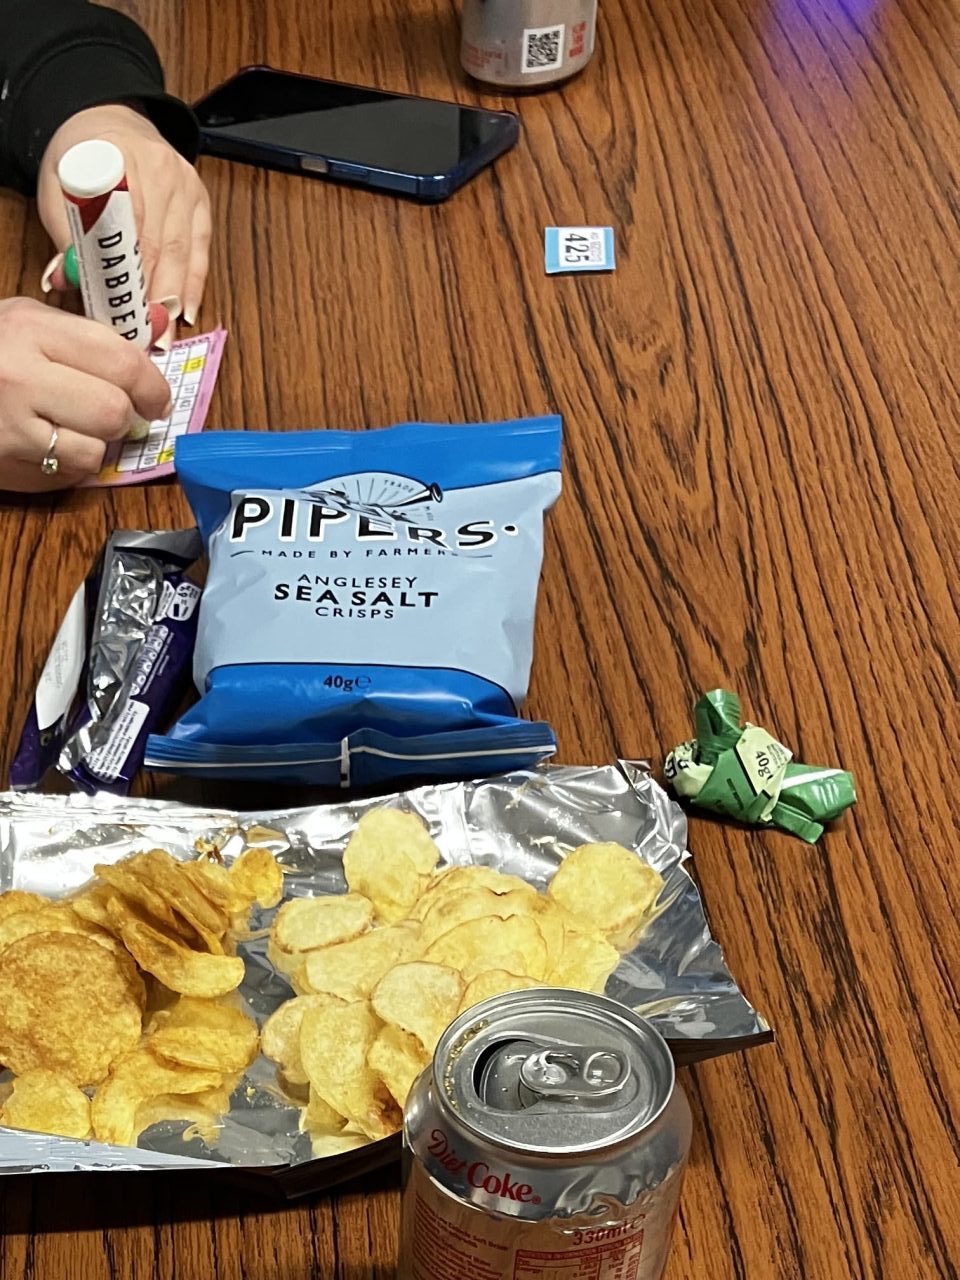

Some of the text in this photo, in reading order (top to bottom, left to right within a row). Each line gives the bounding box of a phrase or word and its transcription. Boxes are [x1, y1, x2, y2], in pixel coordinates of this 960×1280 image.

[564, 232, 589, 263] 425
[97, 230, 139, 342] DABBER
[262, 547, 458, 559] MADE BY FARMER
[297, 573, 418, 590] ANGLESEY
[274, 583, 439, 608] SEA SALT
[315, 606, 395, 619] CRISPS
[427, 1129, 533, 1203] Diet Coke
